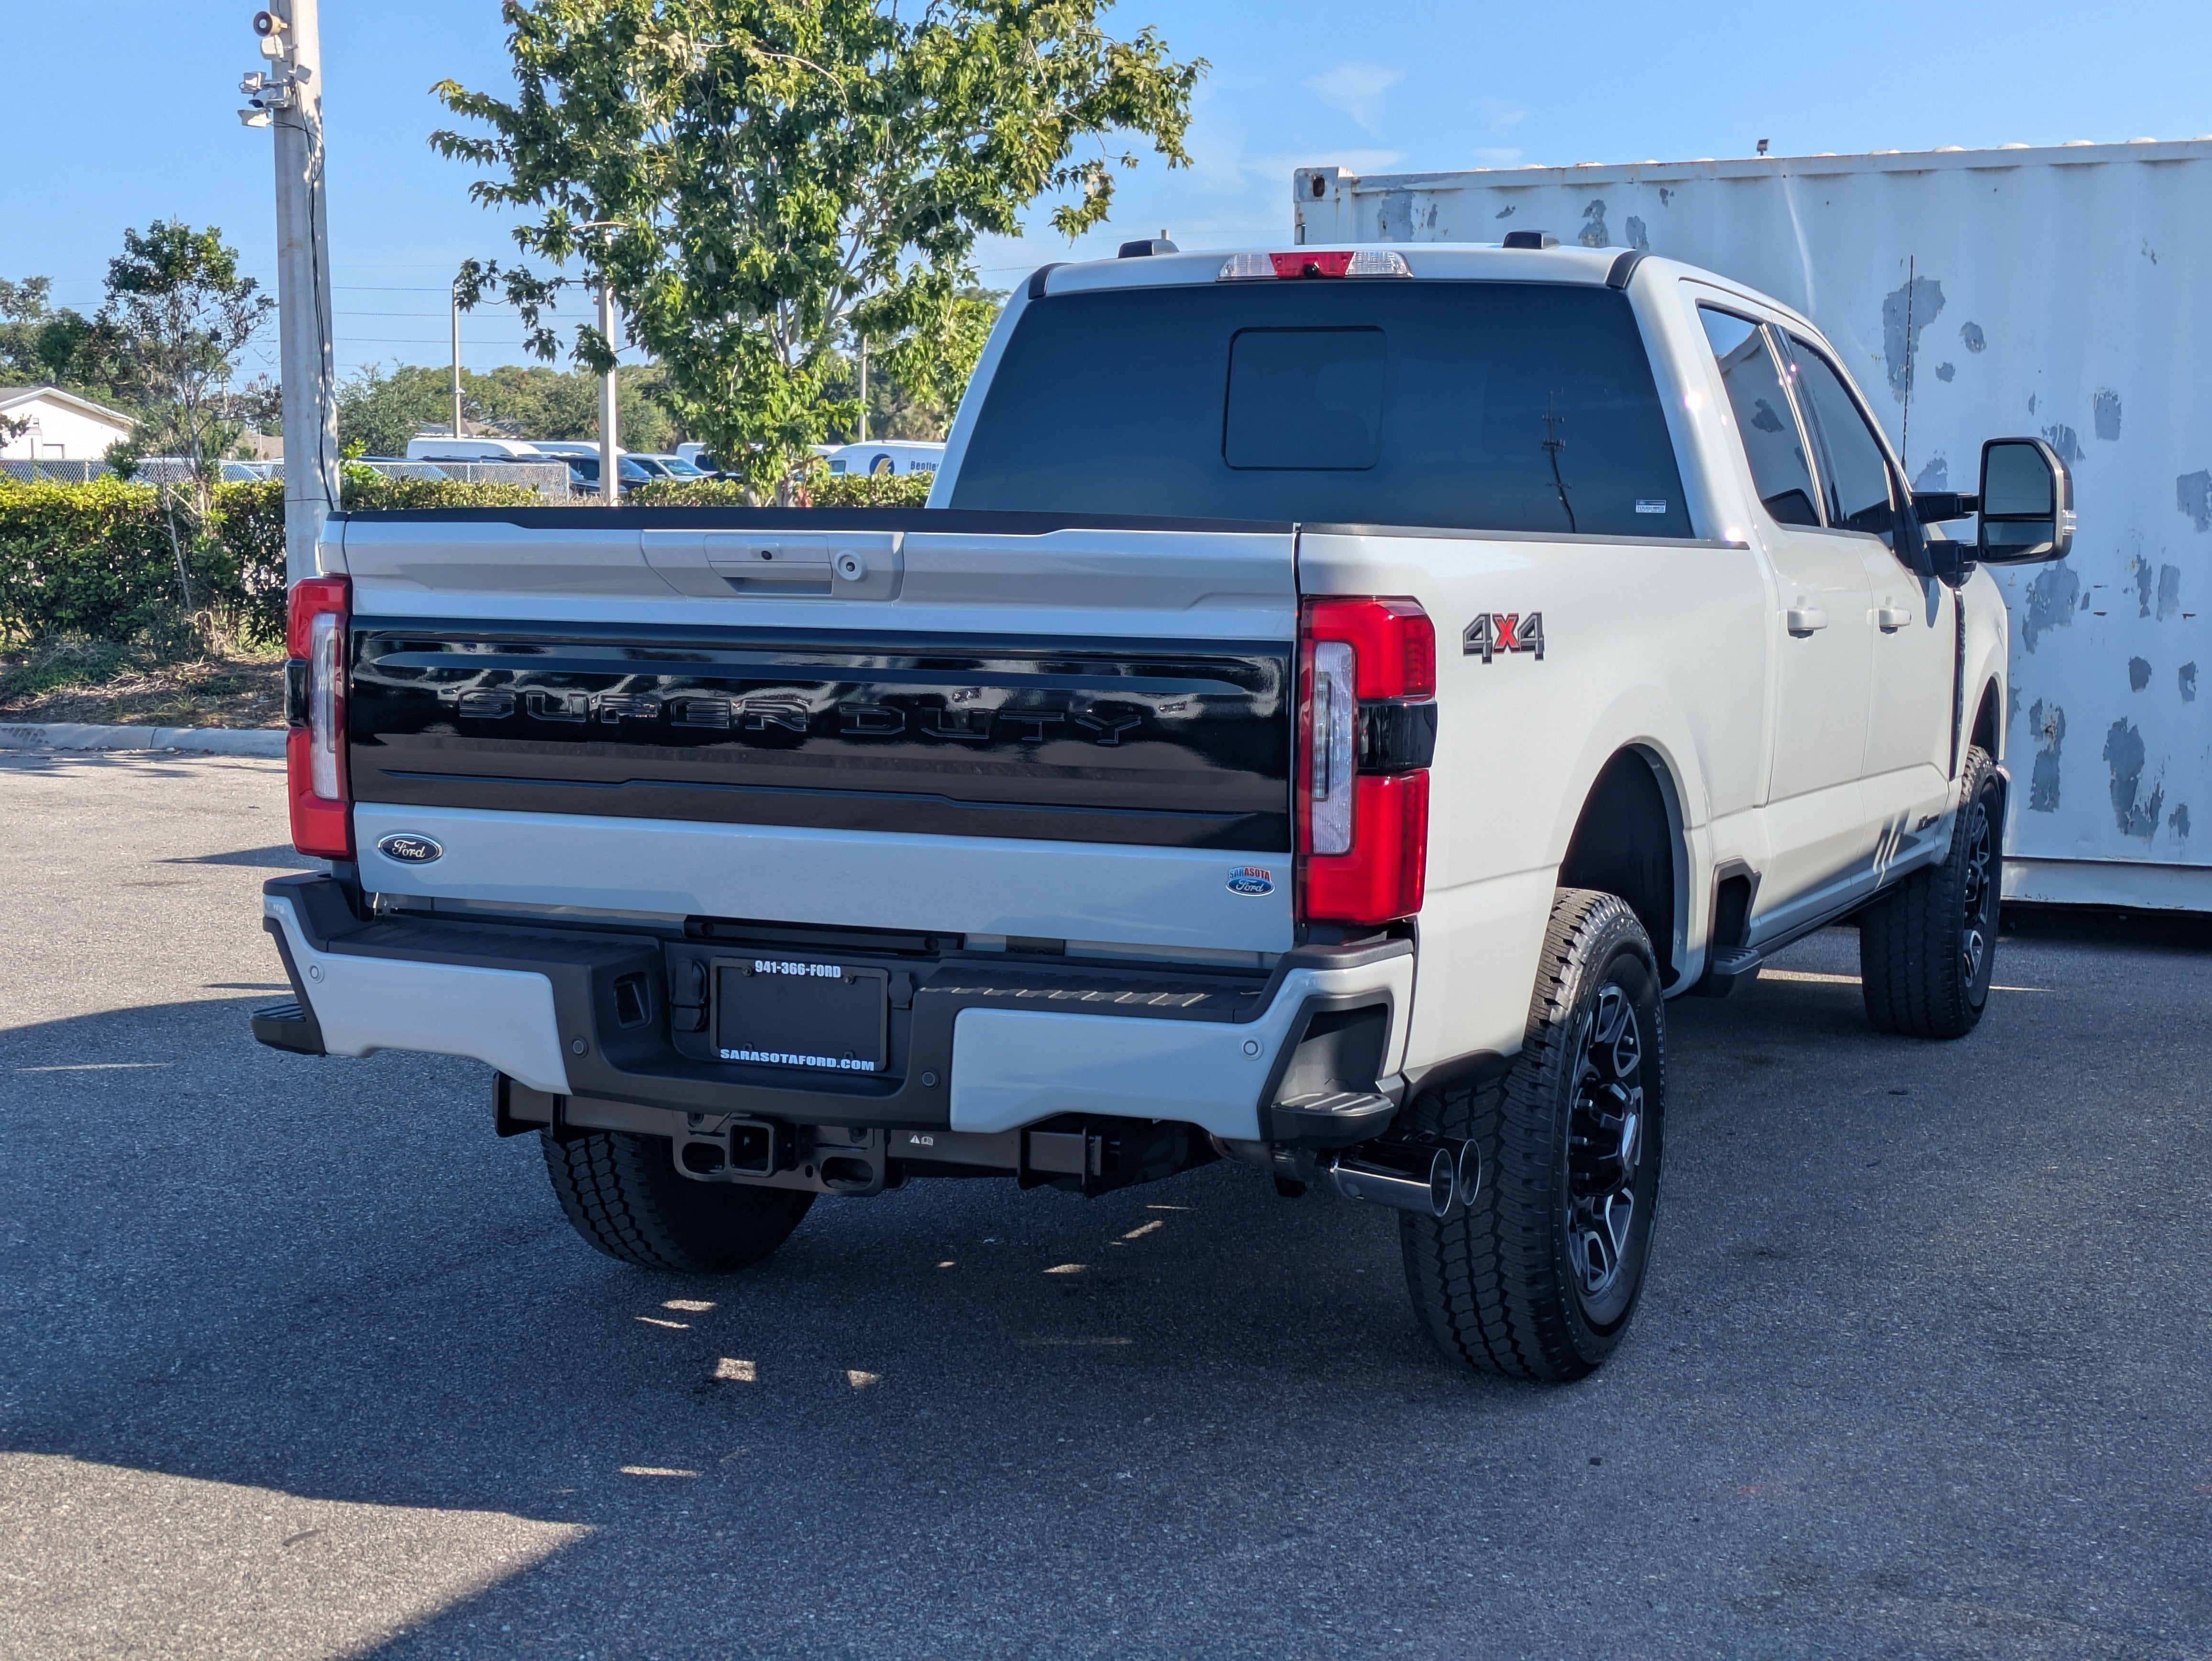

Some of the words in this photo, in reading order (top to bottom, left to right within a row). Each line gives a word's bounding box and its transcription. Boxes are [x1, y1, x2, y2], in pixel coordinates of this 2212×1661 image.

[910, 461, 939, 471] Bentle
[457, 687, 808, 732] SUPER
[839, 703, 1141, 744] DUTY
[392, 840, 426, 858] Ford
[1229, 868, 1271, 880] SARASOTA
[1236, 879, 1264, 892] Ford
[754, 960, 841, 978] 941-366-FORD
[720, 1049, 874, 1071] SARASOTAFORD.COM
